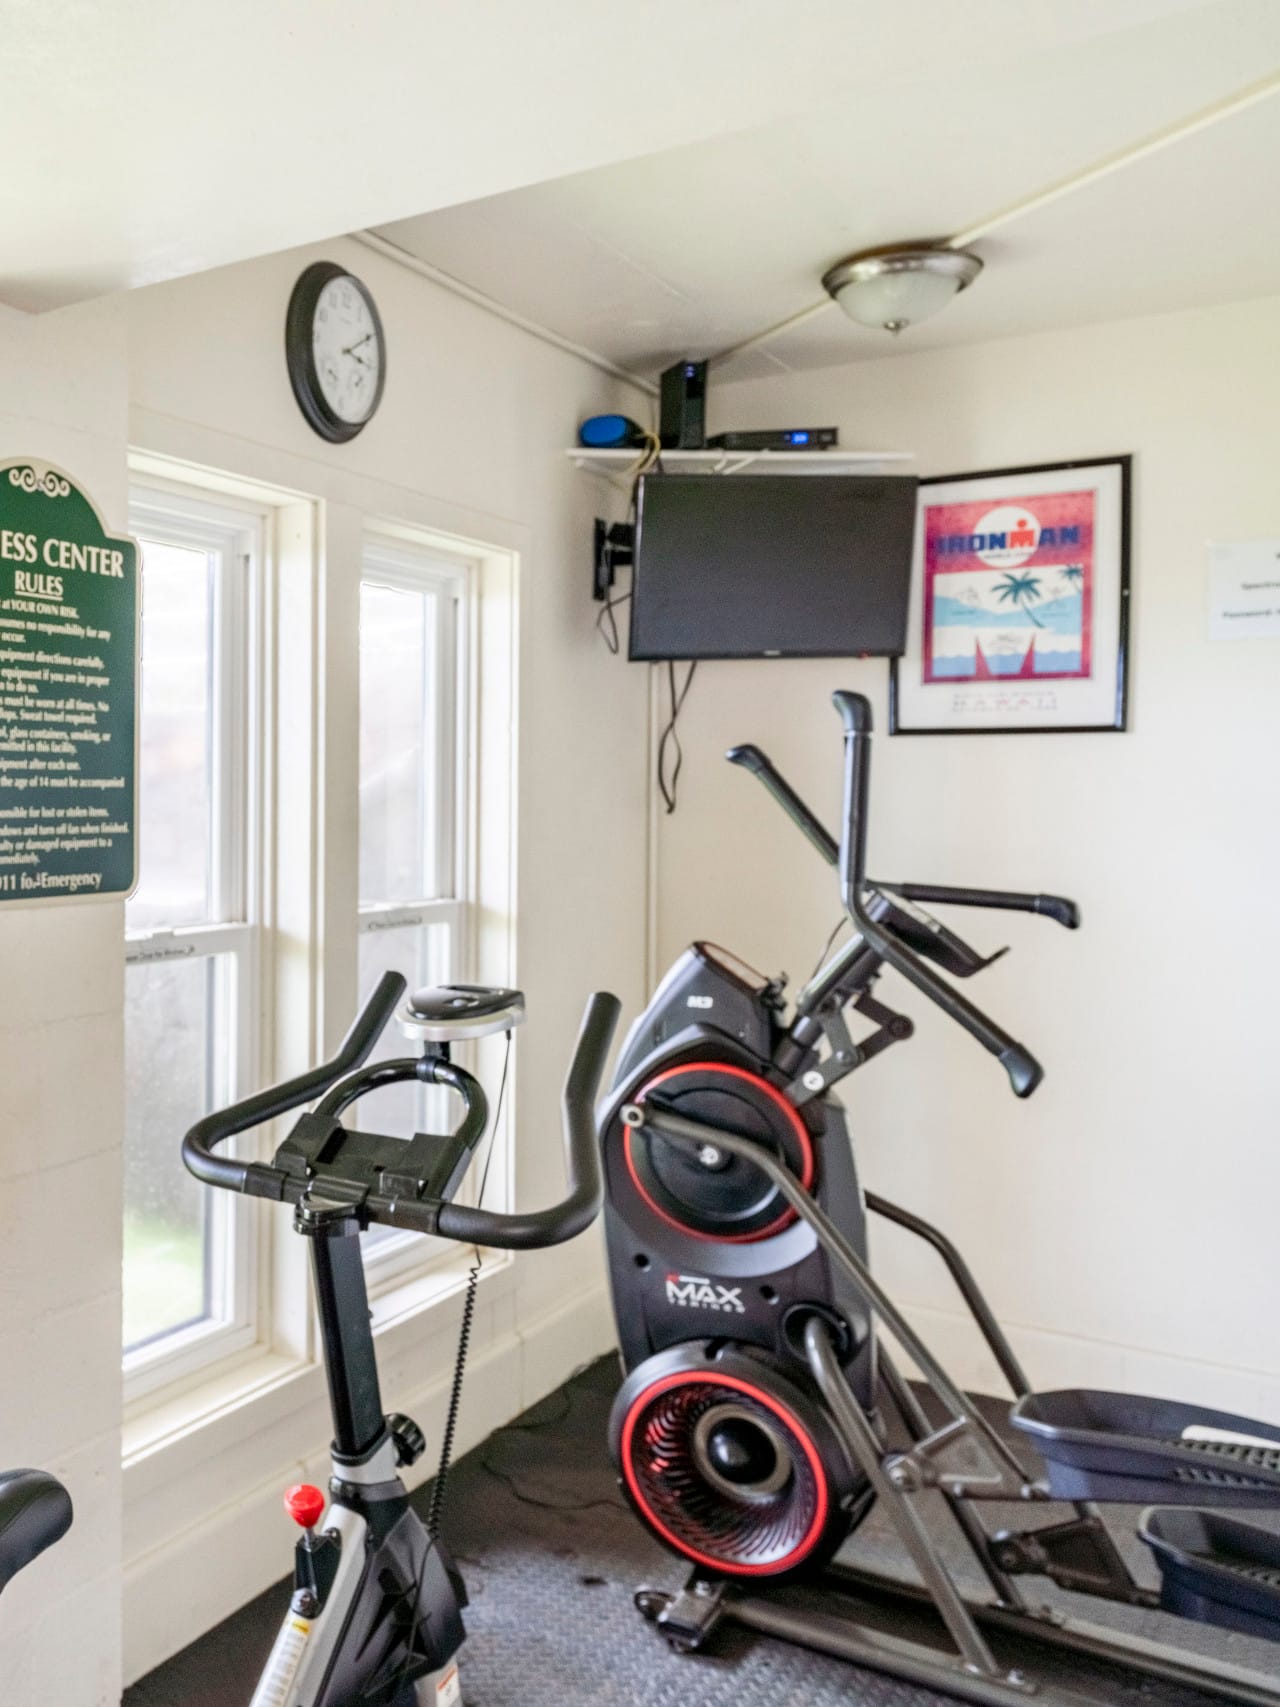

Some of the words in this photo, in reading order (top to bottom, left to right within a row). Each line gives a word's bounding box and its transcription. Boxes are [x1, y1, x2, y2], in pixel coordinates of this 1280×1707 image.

[937, 519, 1080, 553] IRONMAN
[42, 538, 124, 578] CENTER
[14, 570, 64, 597] RULES
[10, 599, 35, 613] YOUR
[36, 602, 58, 616] OWN
[59, 605, 80, 619] RISK.
[37, 622, 85, 639] responsibility
[86, 625, 97, 637] for
[98, 630, 111, 642] any
[36, 651, 72, 665] directions
[1, 666, 42, 681] equipment
[50, 672, 65, 683] you
[4, 696, 24, 706] must
[47, 759, 66, 770] each
[0, 775, 13, 787] the
[50, 777, 68, 787] must
[79, 776, 125, 791] accompanied
[28, 806, 40, 818] for
[23, 824, 38, 836] and
[25, 837, 60, 852] damaged
[60, 837, 98, 851] equipment
[41, 872, 102, 892] Emergency
[666, 1280, 743, 1305] MAX
